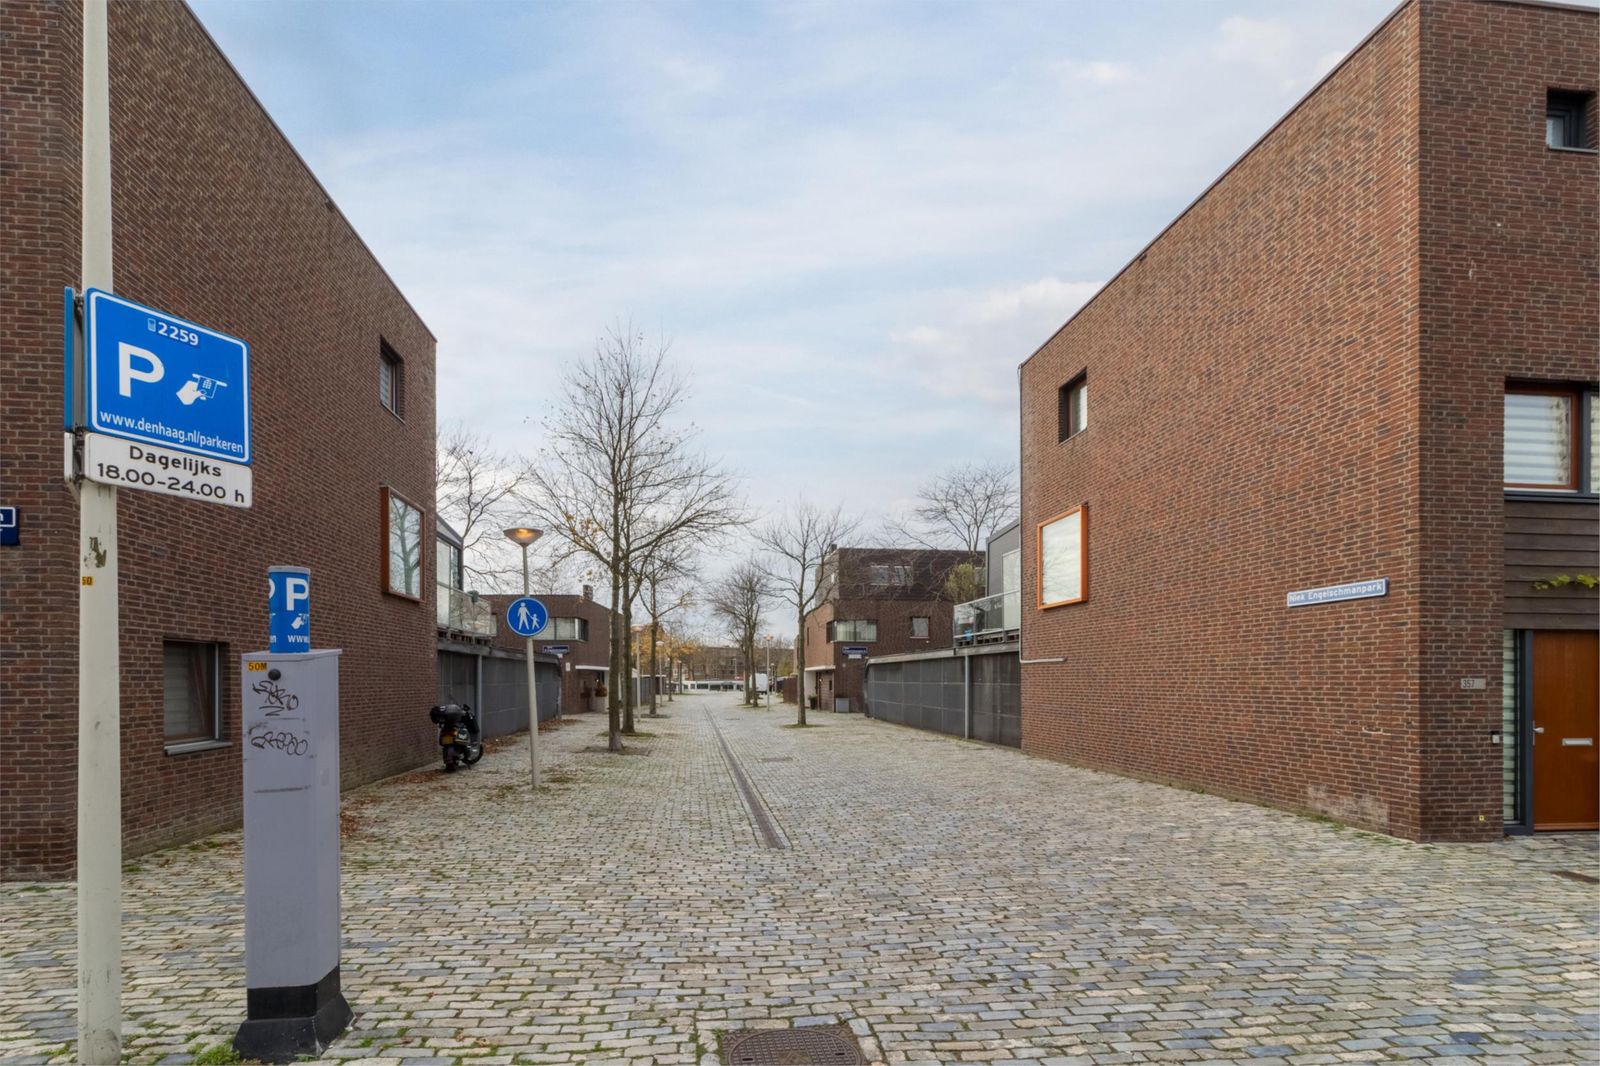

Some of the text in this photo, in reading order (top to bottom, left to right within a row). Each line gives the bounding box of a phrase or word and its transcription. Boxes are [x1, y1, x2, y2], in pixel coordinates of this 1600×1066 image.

[157, 321, 199, 346] 2259
[118, 341, 165, 398] P
[100, 410, 243, 454] www.denhaag.nl/parkeren
[129, 445, 222, 477] Dagelijks
[97, 462, 245, 503] 18.00-24.00 h
[286, 577, 309, 611] P
